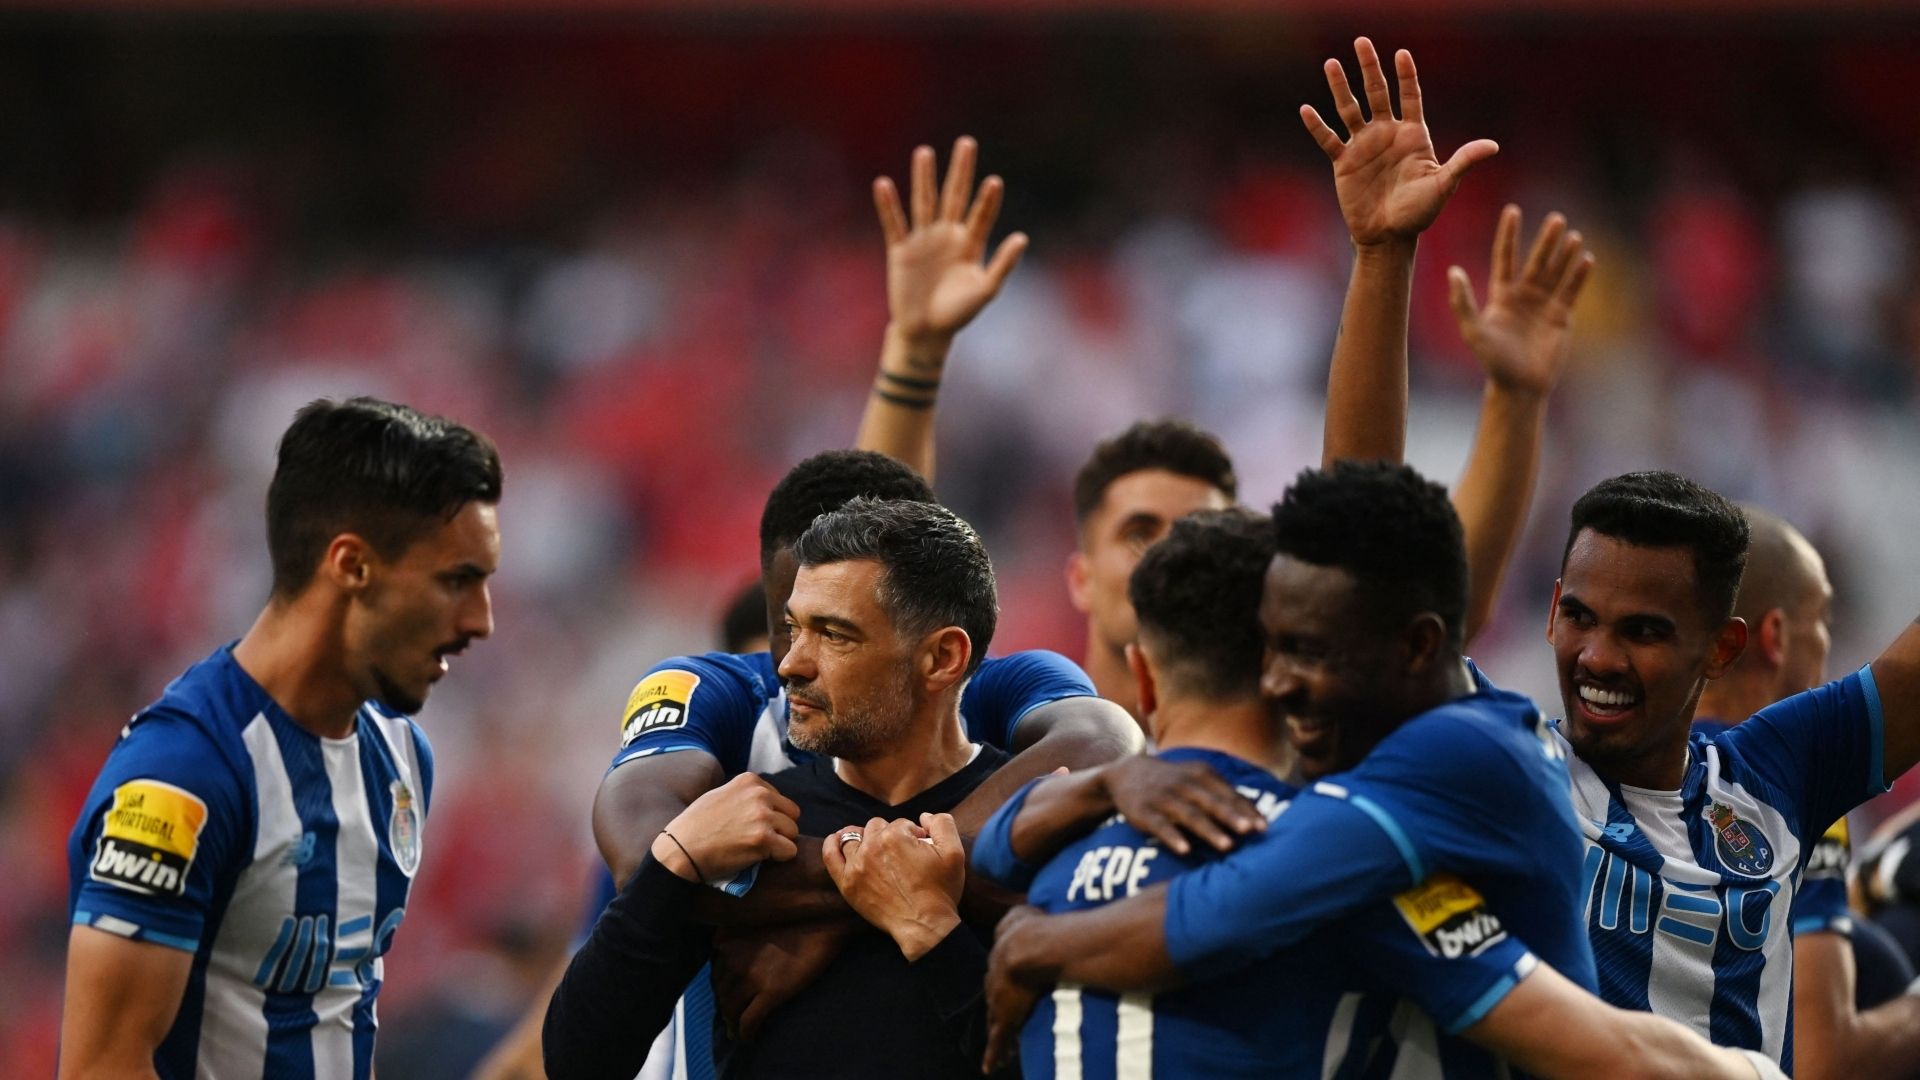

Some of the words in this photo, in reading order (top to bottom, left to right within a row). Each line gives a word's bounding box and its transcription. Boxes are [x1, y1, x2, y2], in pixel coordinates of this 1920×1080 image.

[95, 840, 179, 889] bwin
[1583, 845, 1782, 951] MEO
[253, 907, 405, 993] MEO
[1434, 911, 1502, 959] bwin
